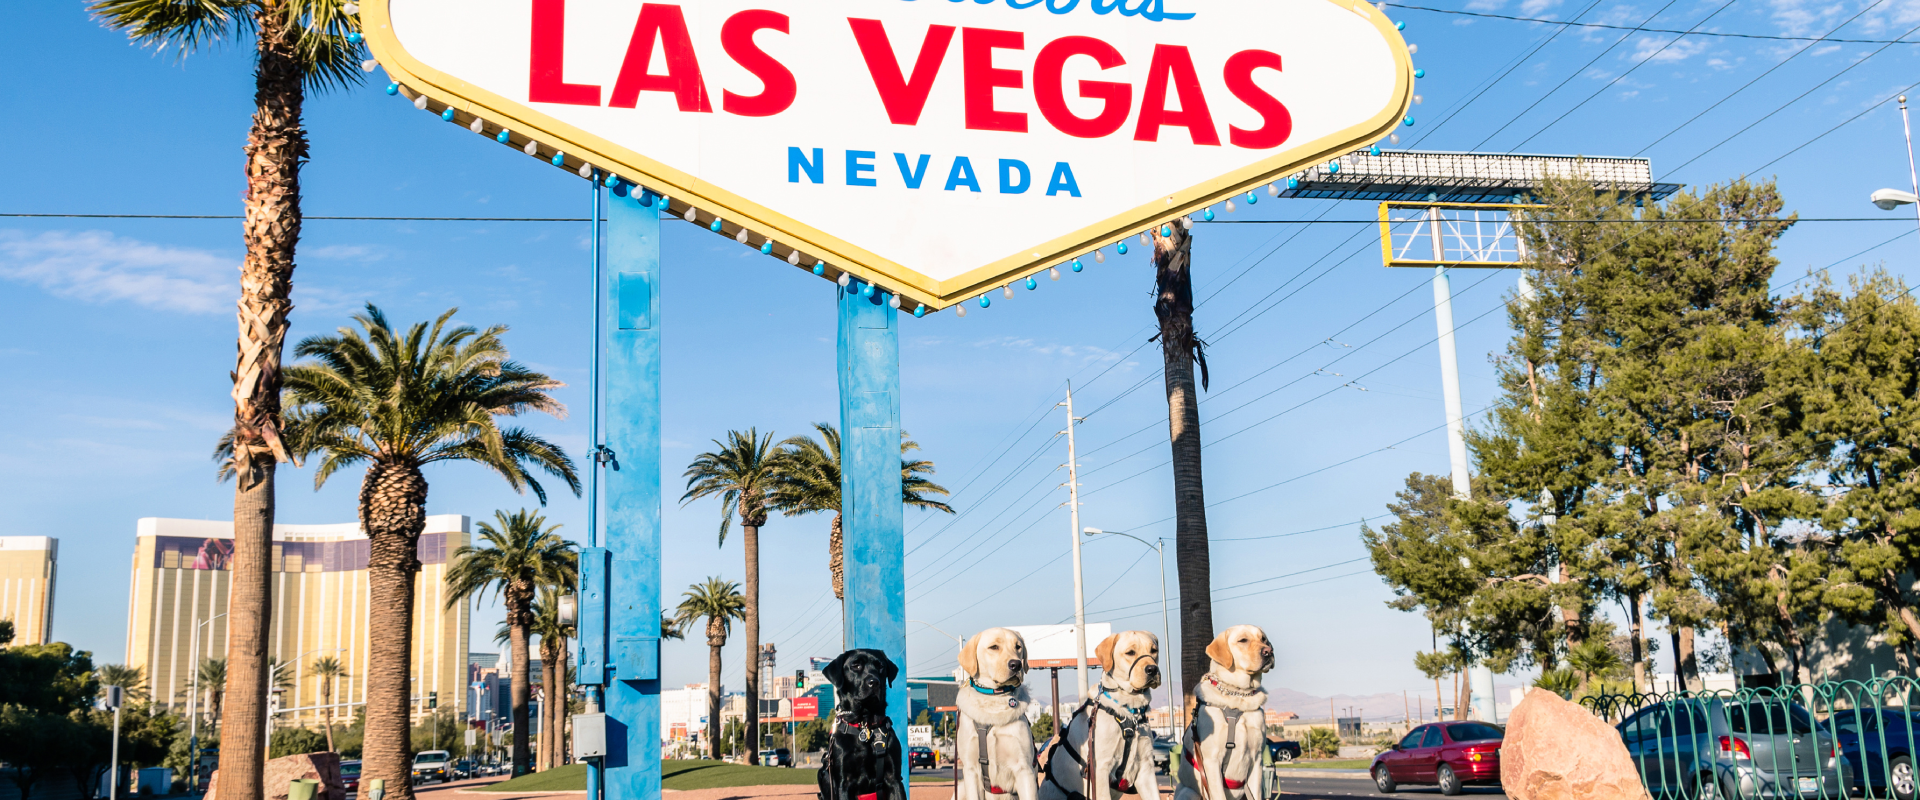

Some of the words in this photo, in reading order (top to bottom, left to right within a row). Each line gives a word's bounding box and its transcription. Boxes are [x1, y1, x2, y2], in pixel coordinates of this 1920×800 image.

[528, 0, 797, 117] LAS
[846, 16, 1293, 149] VEGAS
[787, 146, 1082, 198] NEVADA
[909, 726, 930, 734] SALE
